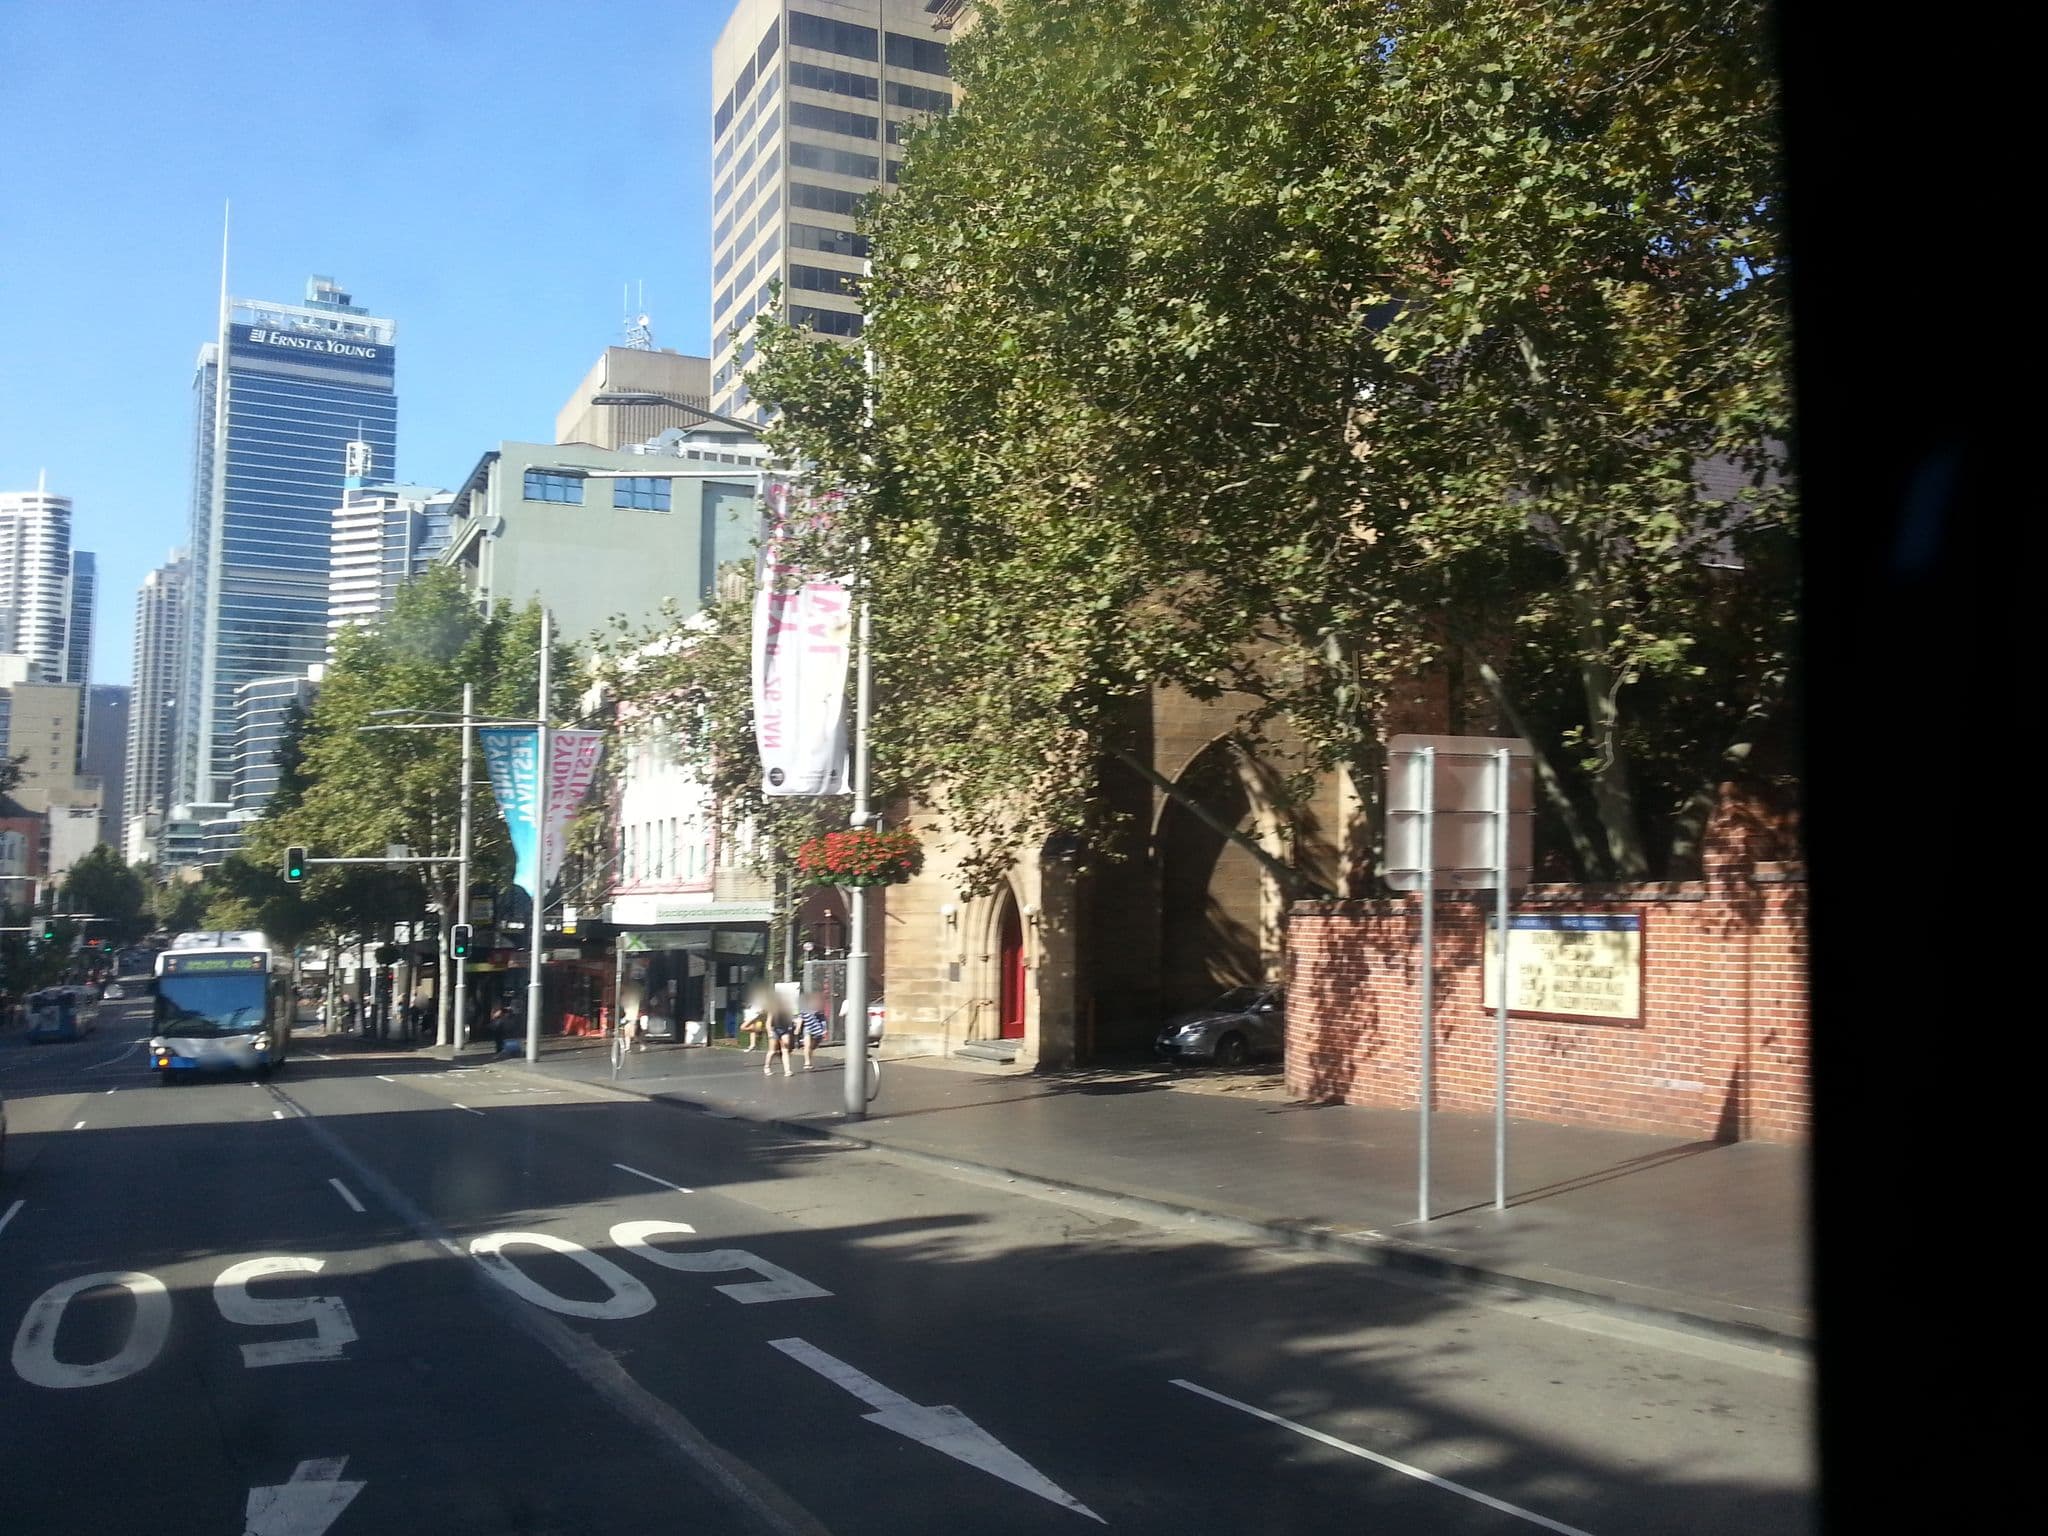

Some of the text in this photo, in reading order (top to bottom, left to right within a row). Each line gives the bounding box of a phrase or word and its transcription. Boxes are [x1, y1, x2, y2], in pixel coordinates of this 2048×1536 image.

[269, 331, 377, 359] ERNST & YOUNG
[469, 1220, 835, 1320] 50
[11, 1256, 358, 1389] 50
